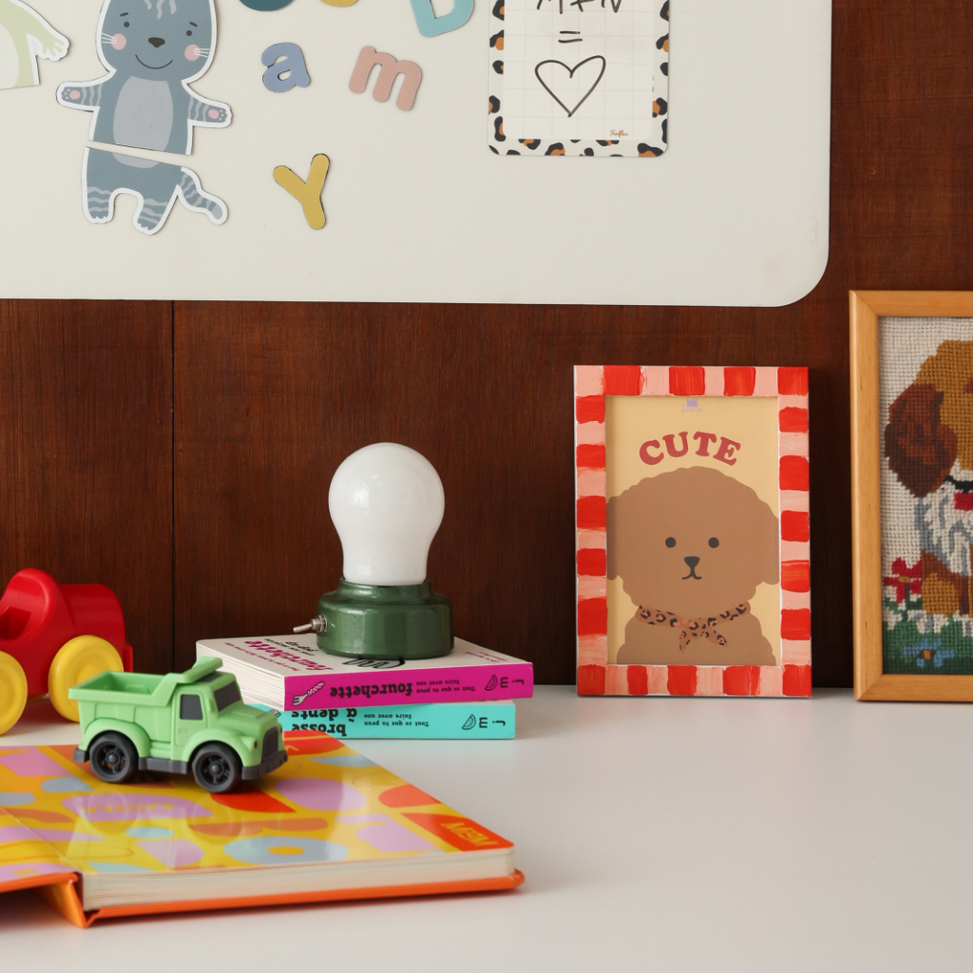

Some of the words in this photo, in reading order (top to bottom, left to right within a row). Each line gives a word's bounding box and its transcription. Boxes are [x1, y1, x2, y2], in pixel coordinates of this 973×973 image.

[639, 431, 741, 466] CUTE
[330, 682, 413, 699] fourchette
[291, 708, 339, 721] dents
[346, 708, 357, 722] à
